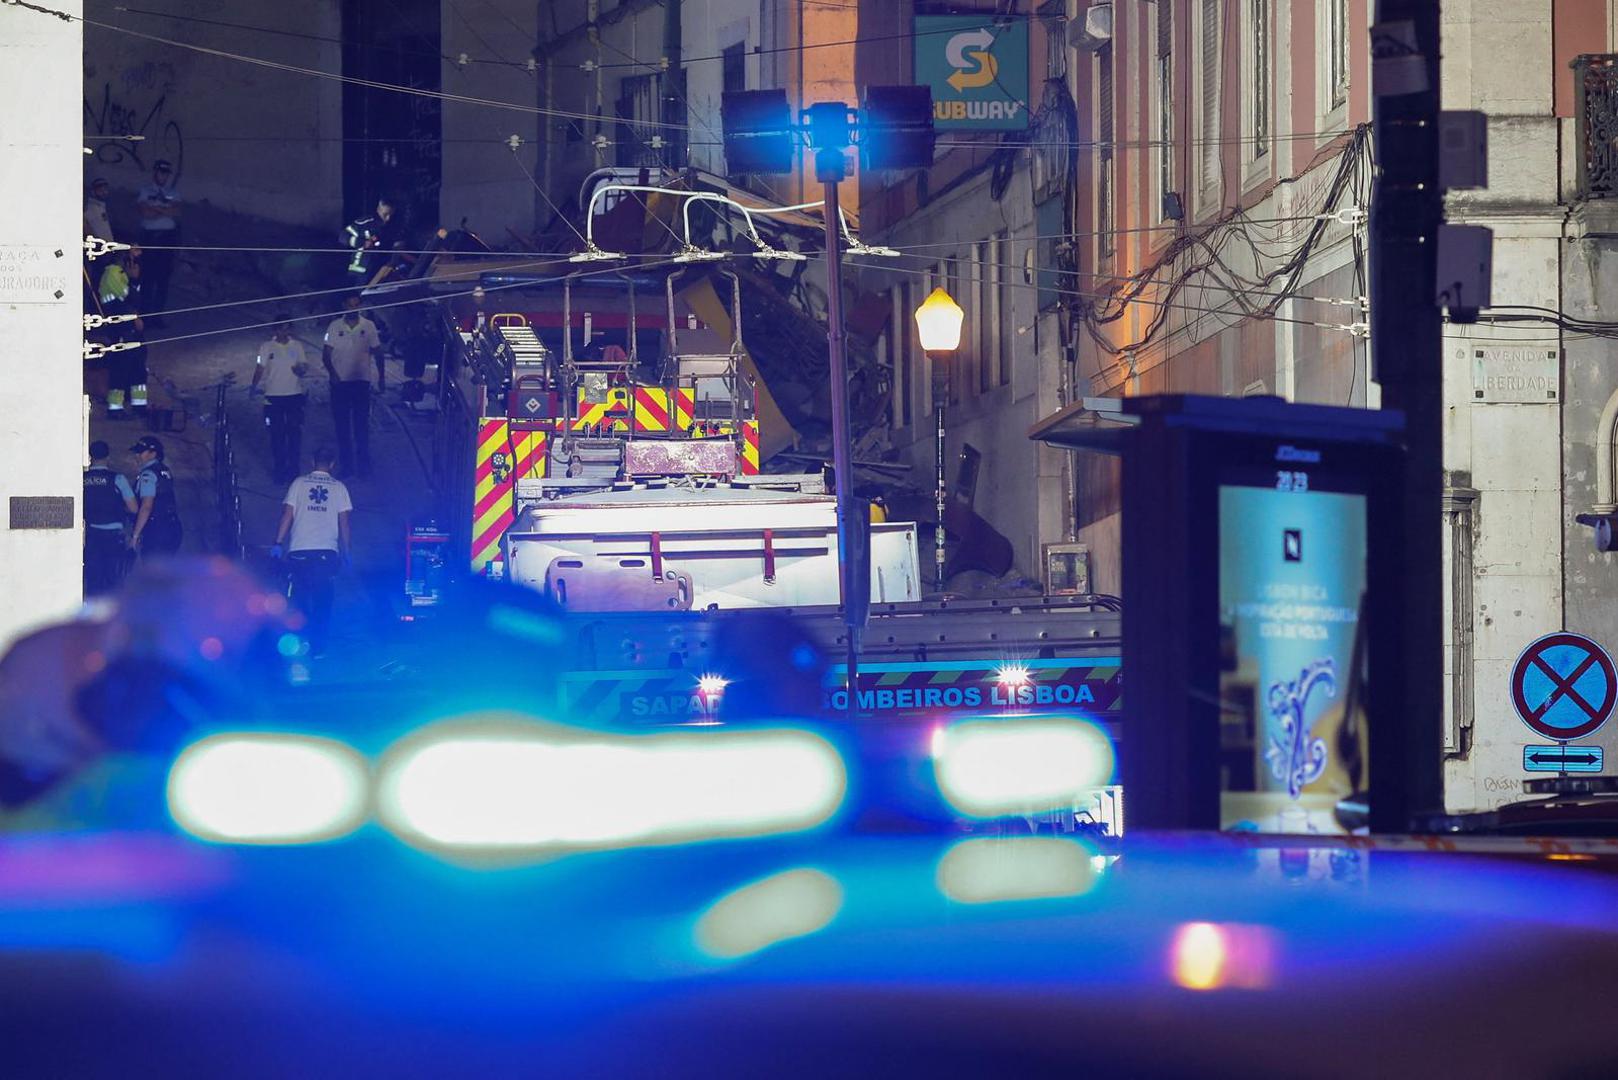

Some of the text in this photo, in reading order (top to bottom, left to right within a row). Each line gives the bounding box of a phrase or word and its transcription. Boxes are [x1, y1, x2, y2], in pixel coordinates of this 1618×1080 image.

[1484, 351, 1547, 362] AVENIDA
[1473, 376, 1556, 391] LIBERDADE
[824, 687, 981, 711] OMBEIROS
[991, 684, 1095, 706] LISBOA
